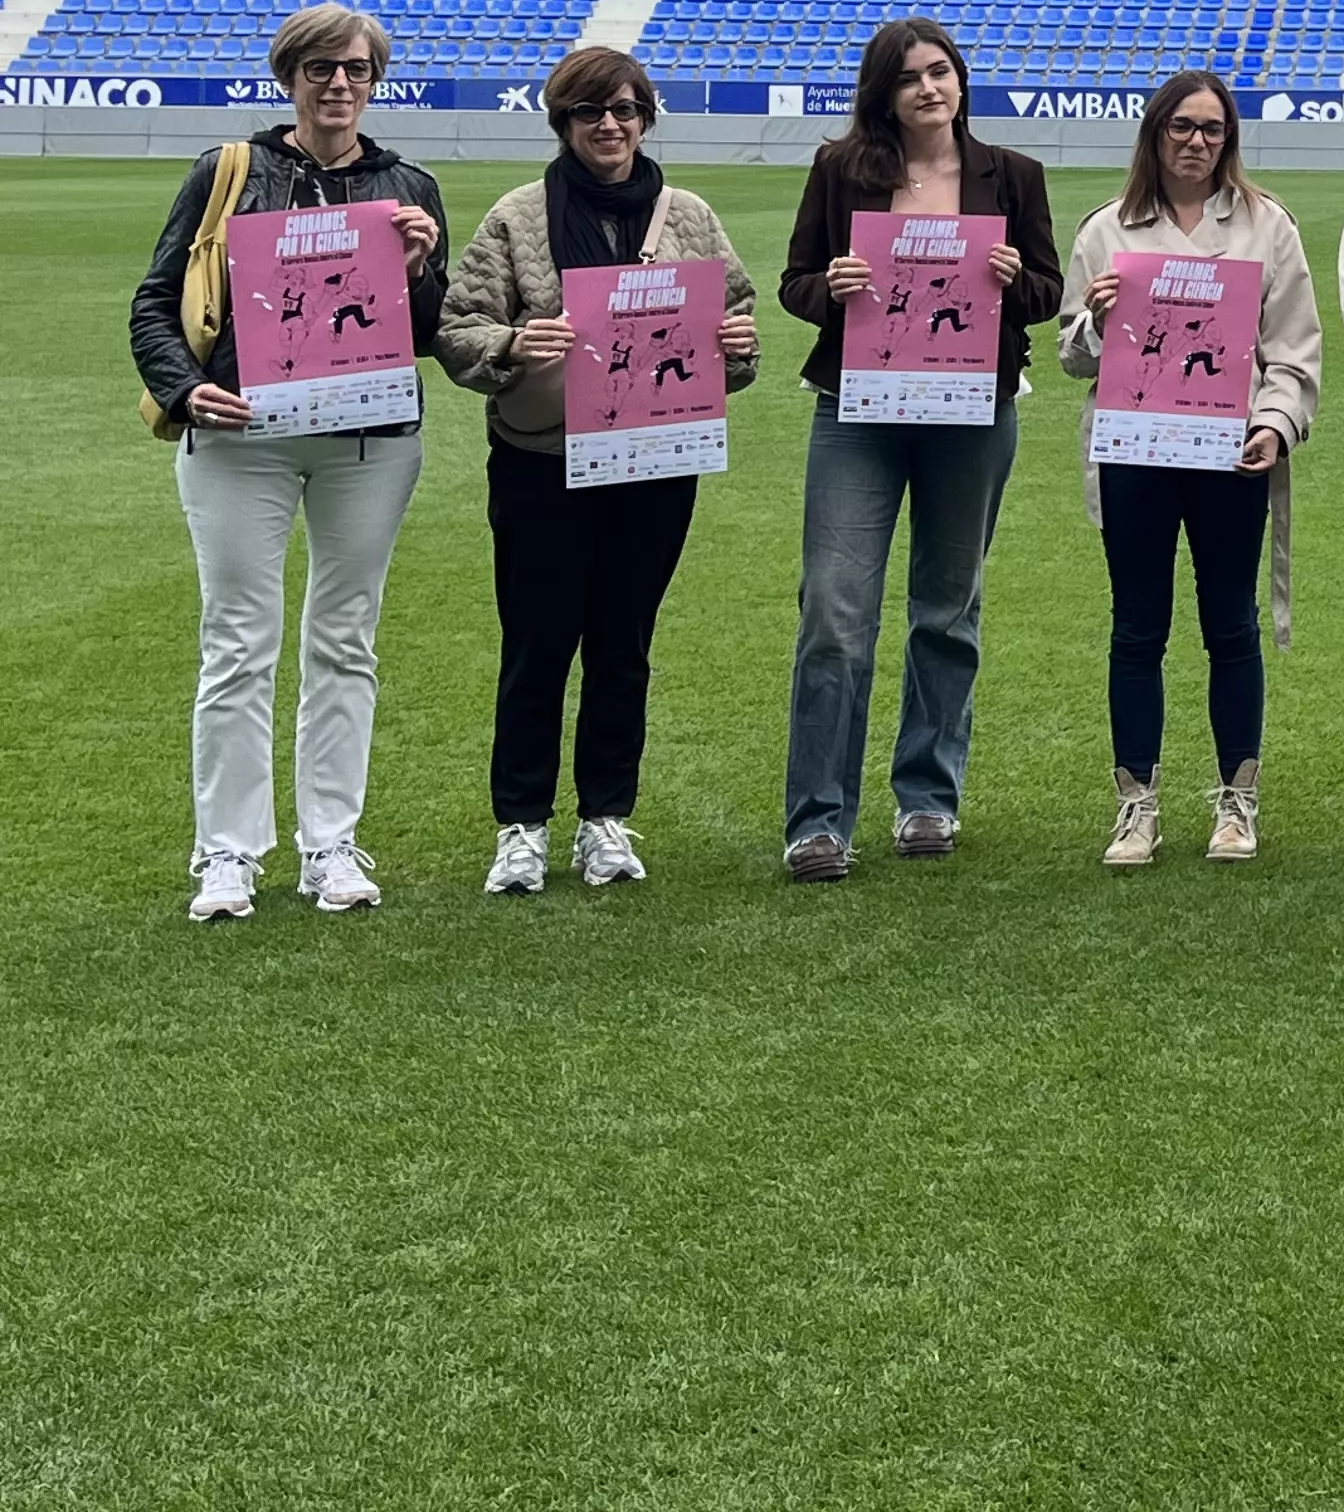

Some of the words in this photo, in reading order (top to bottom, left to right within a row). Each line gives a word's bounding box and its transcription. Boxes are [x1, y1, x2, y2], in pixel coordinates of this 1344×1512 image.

[255, 80, 289, 99] BN
[806, 99, 821, 112] de
[1034, 92, 1146, 119] AMBAR
[301, 234, 314, 255] LA
[914, 238, 926, 256] LA
[1170, 279, 1184, 299] LA
[631, 290, 645, 309] LA
